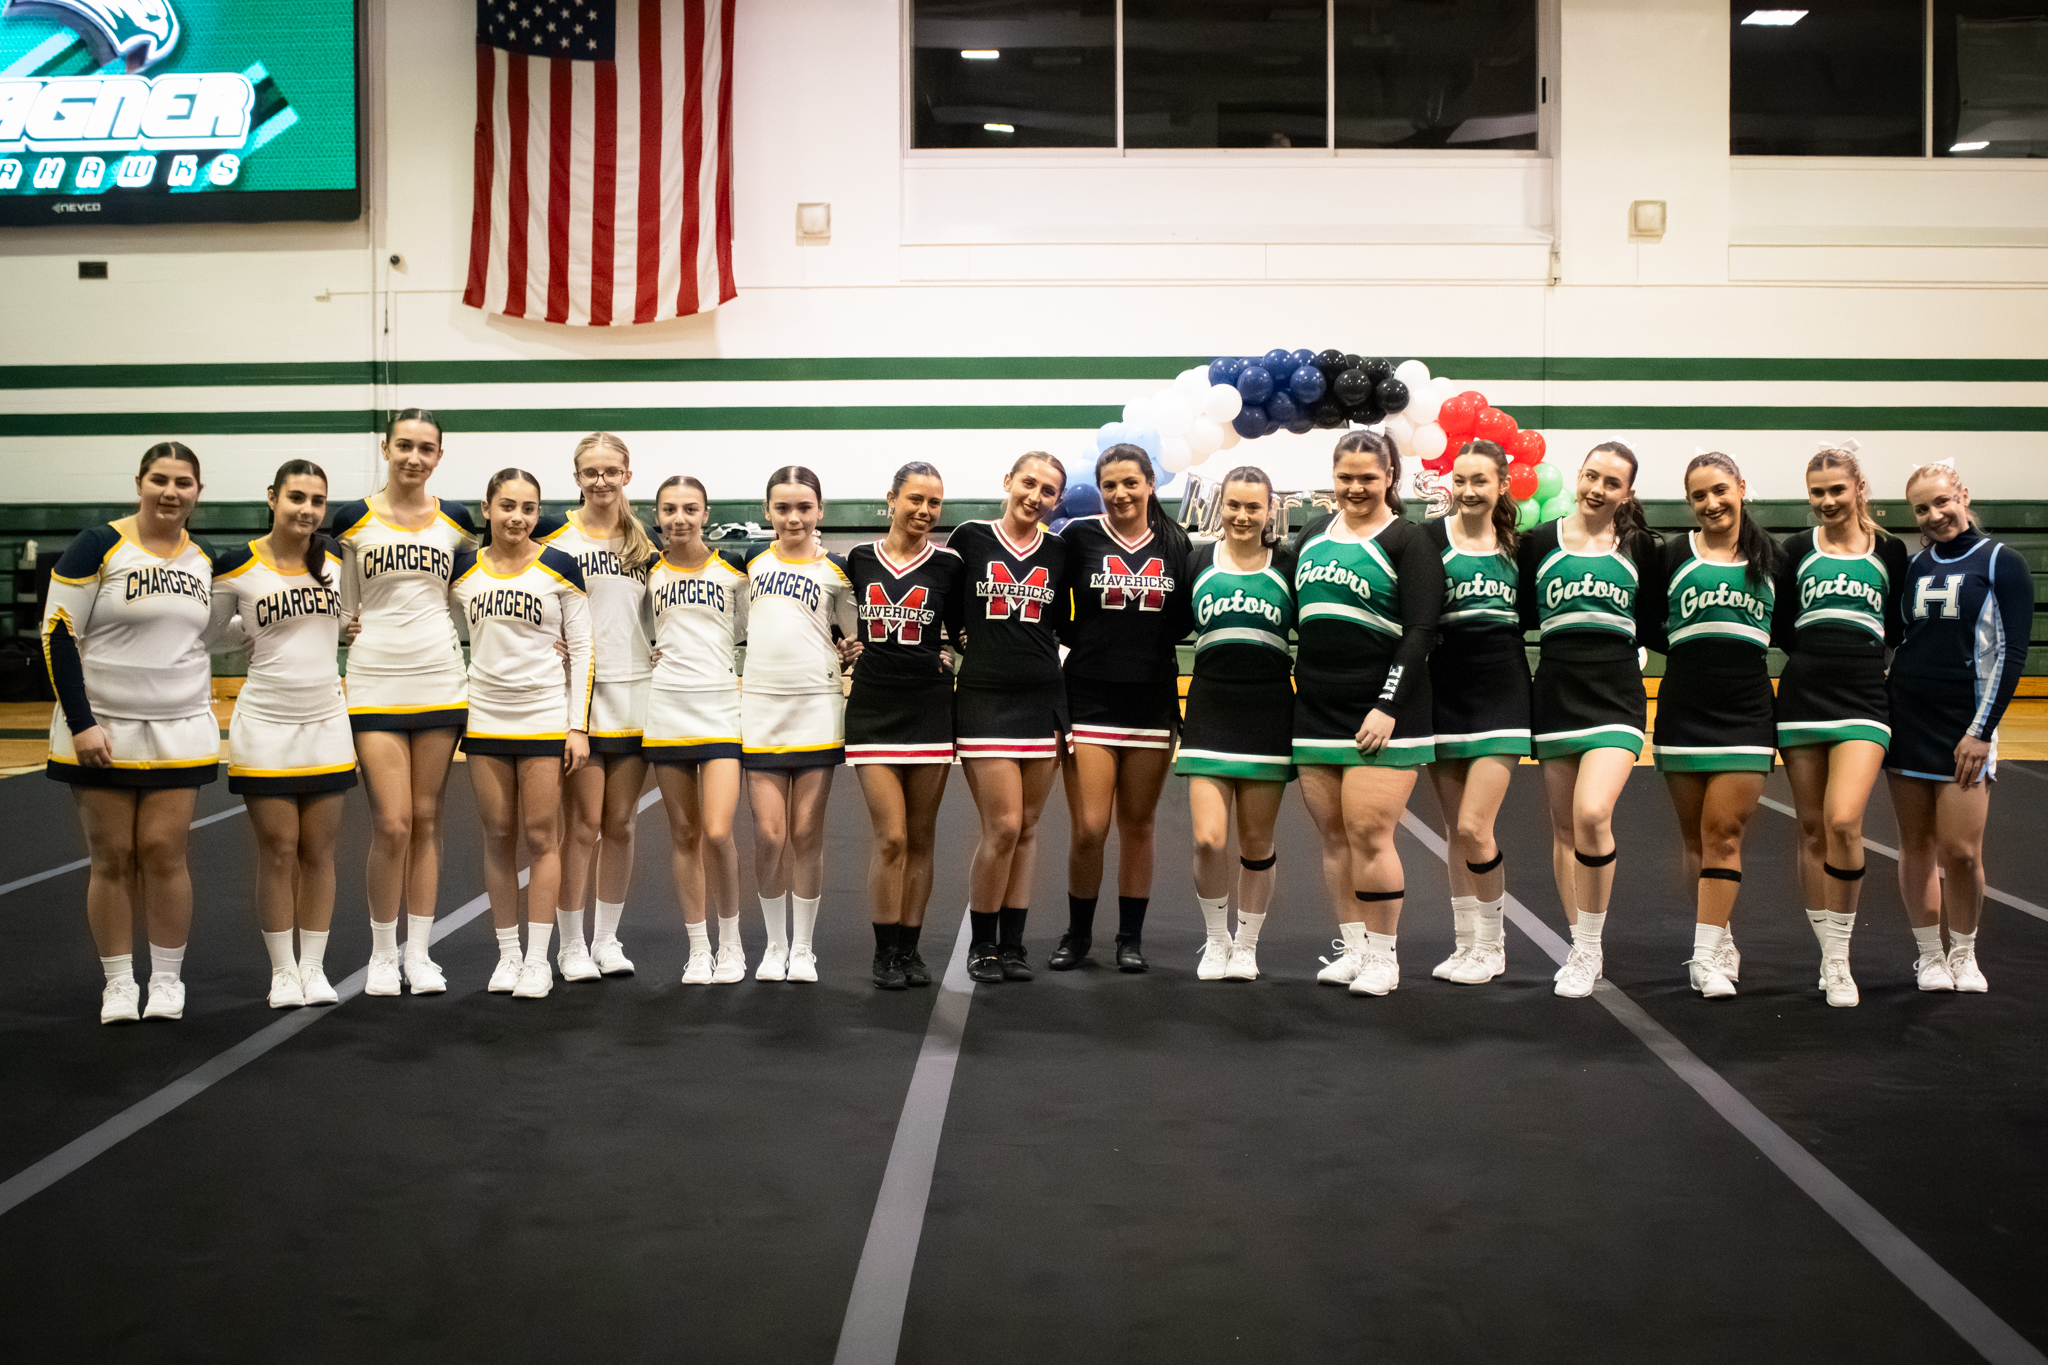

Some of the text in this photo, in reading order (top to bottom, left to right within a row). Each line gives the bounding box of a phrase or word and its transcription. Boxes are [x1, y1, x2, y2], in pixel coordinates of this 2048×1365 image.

[364, 544, 450, 581] CHARGERS
[1092, 574, 1174, 591] MAVERICKS
[1296, 560, 1372, 600] Gators
[126, 567, 209, 608] CHARGERS
[256, 586, 342, 628] CHARGERS
[654, 578, 725, 618] CHARGERS
[750, 571, 821, 613] CHARGERS
[978, 582, 1054, 603] MAVERICKS
[1546, 572, 1629, 610] Gators
[1680, 581, 1765, 622] Gators
[1801, 572, 1883, 613] Gators
[1912, 573, 1966, 620] H
[470, 589, 543, 627] CHARGERS
[860, 604, 935, 624] MAVERICKS
[1198, 589, 1283, 627] Gators
